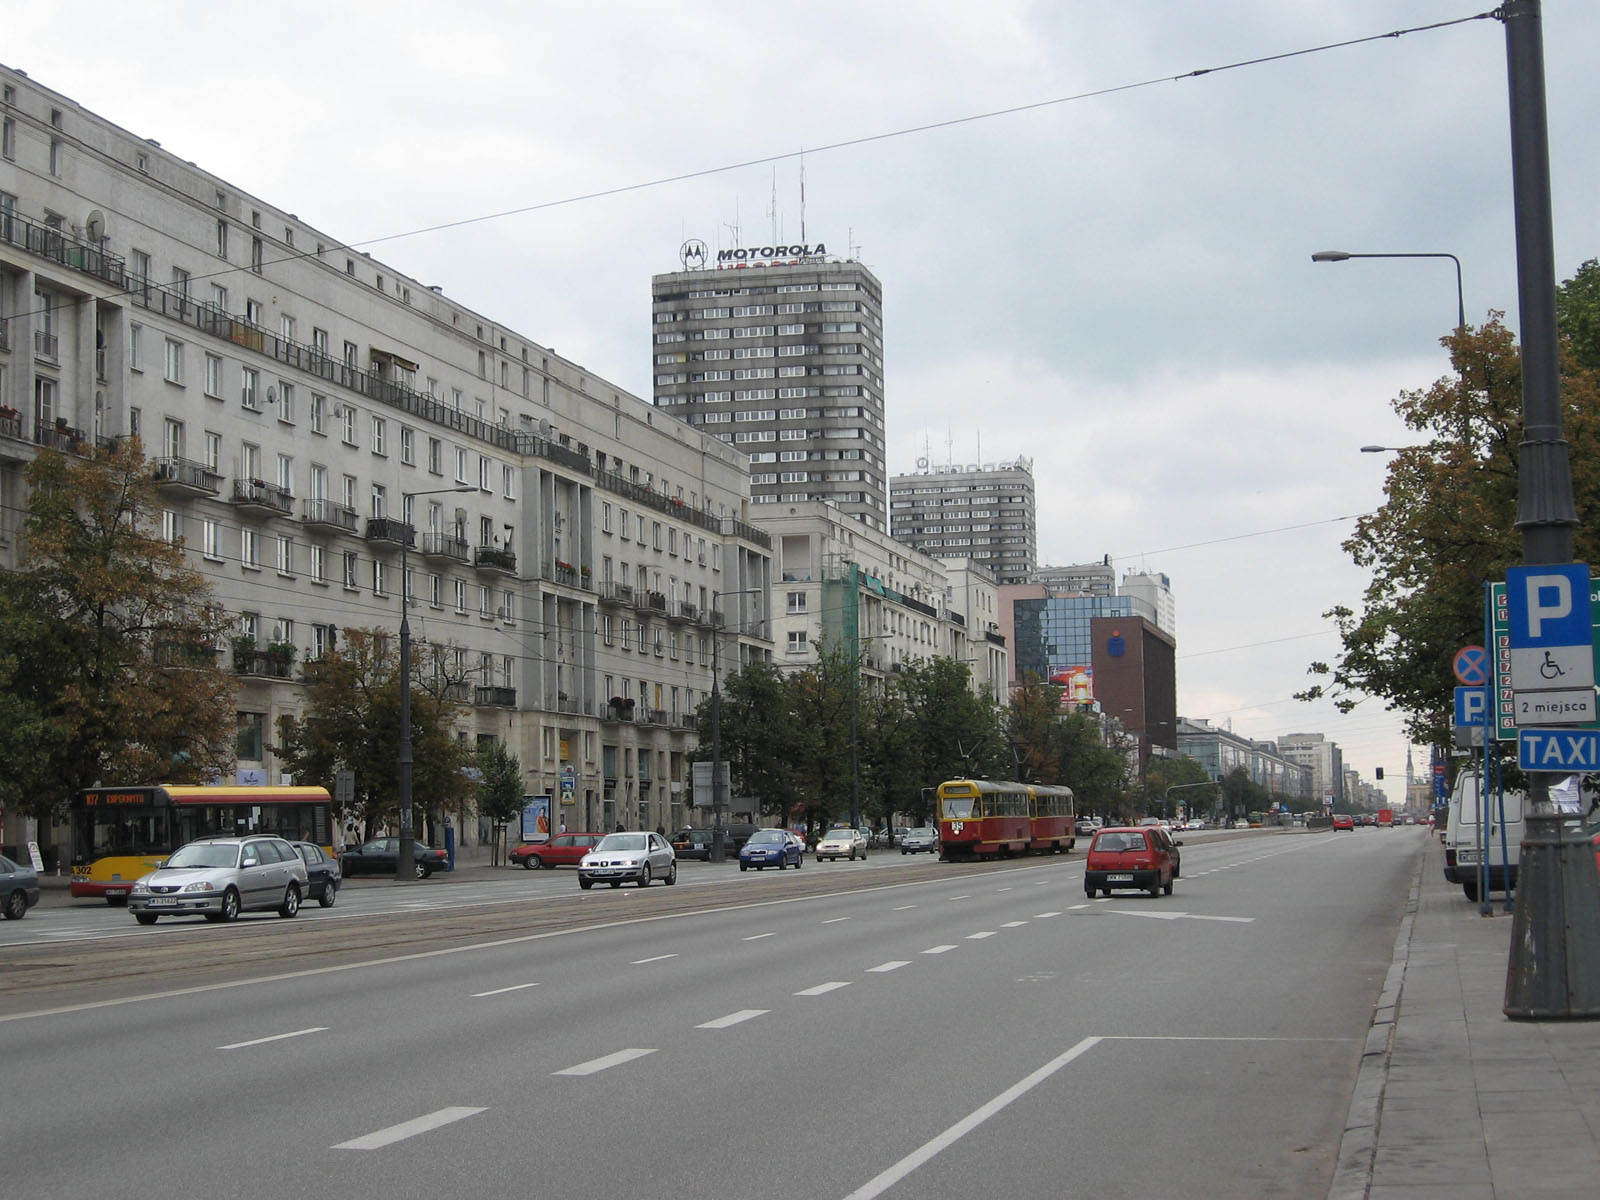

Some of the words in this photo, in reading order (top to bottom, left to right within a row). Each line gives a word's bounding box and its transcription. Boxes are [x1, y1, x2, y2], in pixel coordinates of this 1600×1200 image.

[717, 243, 826, 261] MOTOROLA
[1526, 574, 1572, 638] P
[1463, 691, 1485, 722] P
[1522, 702, 1529, 713] 2
[1535, 700, 1587, 714] miejsca
[1503, 718, 1514, 727] 61
[1523, 735, 1597, 765] TAXI
[952, 821, 963, 830] 35
